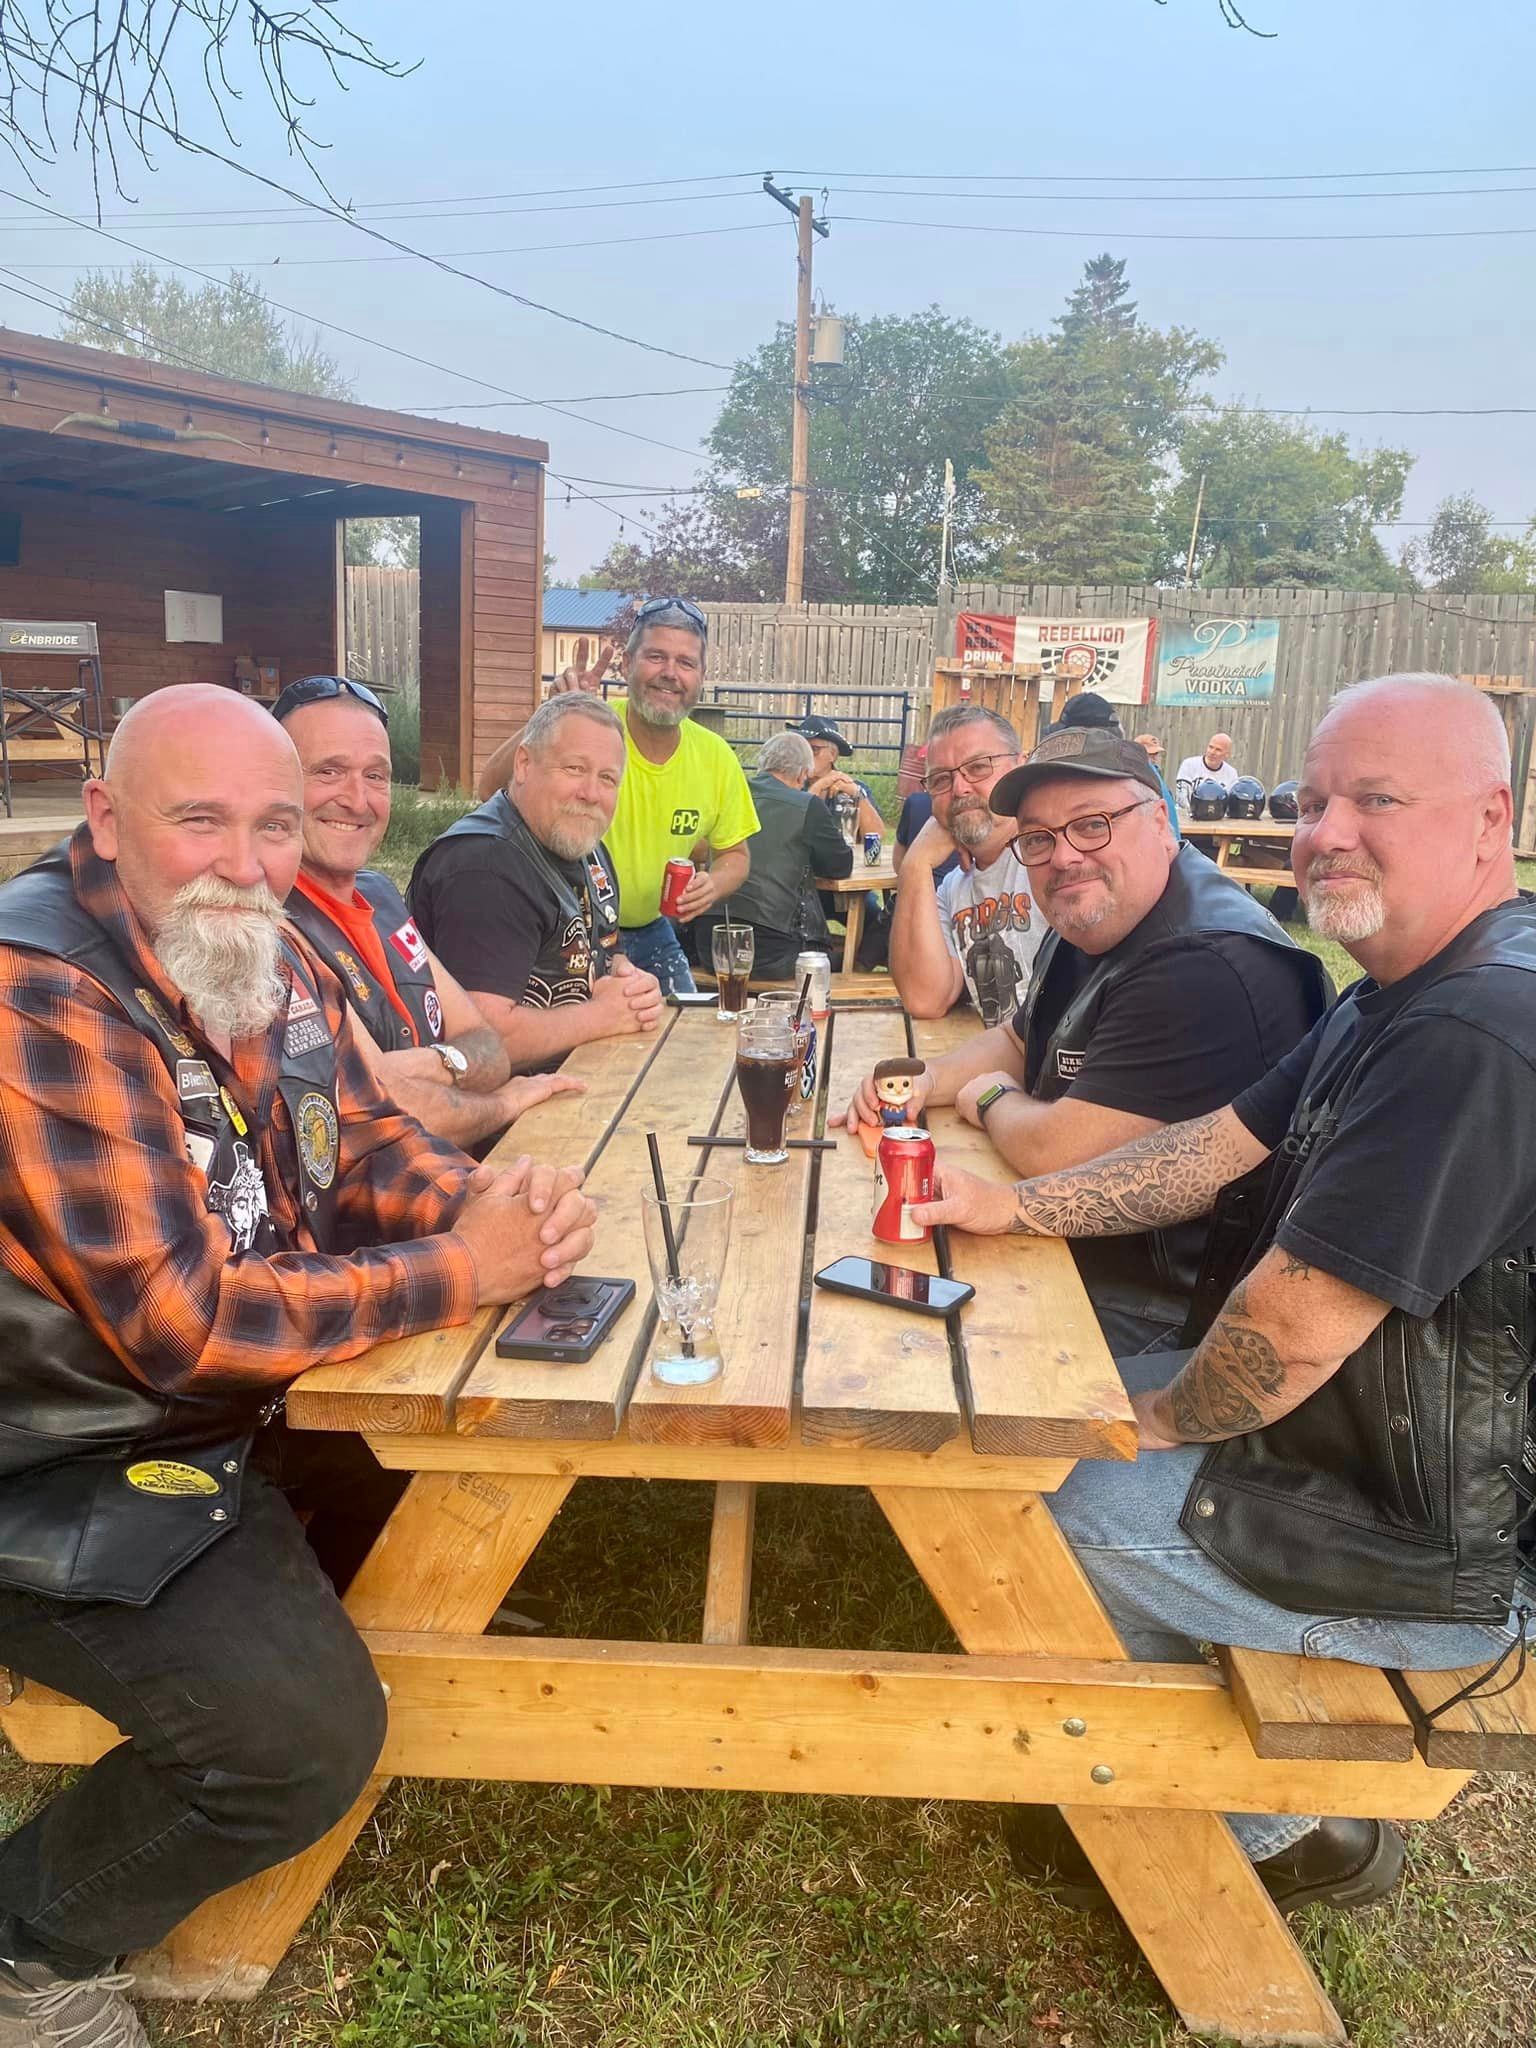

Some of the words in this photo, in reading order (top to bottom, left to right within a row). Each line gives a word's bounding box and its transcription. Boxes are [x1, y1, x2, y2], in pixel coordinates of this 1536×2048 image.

[19, 635, 79, 645] ENBRIDGE
[1038, 626, 1125, 644] REBELLION
[963, 650, 1004, 663] DRINK
[1167, 656, 1267, 680] Provincial
[1185, 679, 1247, 696] VODKA
[672, 811, 699, 834] PPG
